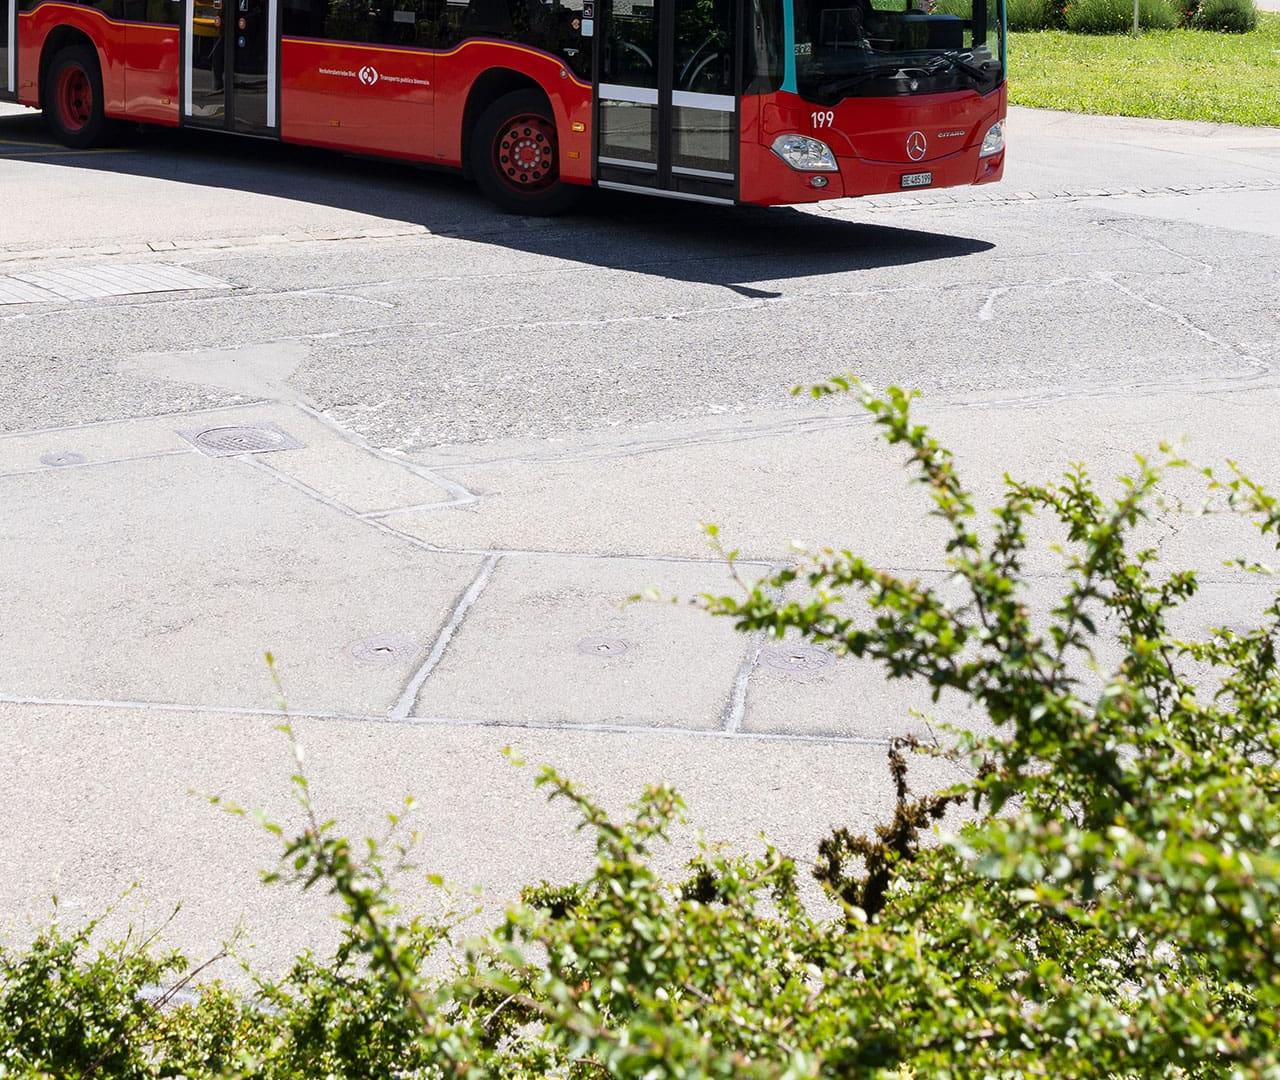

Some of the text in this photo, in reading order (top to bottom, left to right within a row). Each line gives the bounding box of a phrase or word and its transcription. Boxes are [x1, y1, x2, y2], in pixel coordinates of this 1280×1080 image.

[811, 111, 834, 128] 199
[937, 130, 965, 138] CITARO
[903, 176, 910, 185] BE
